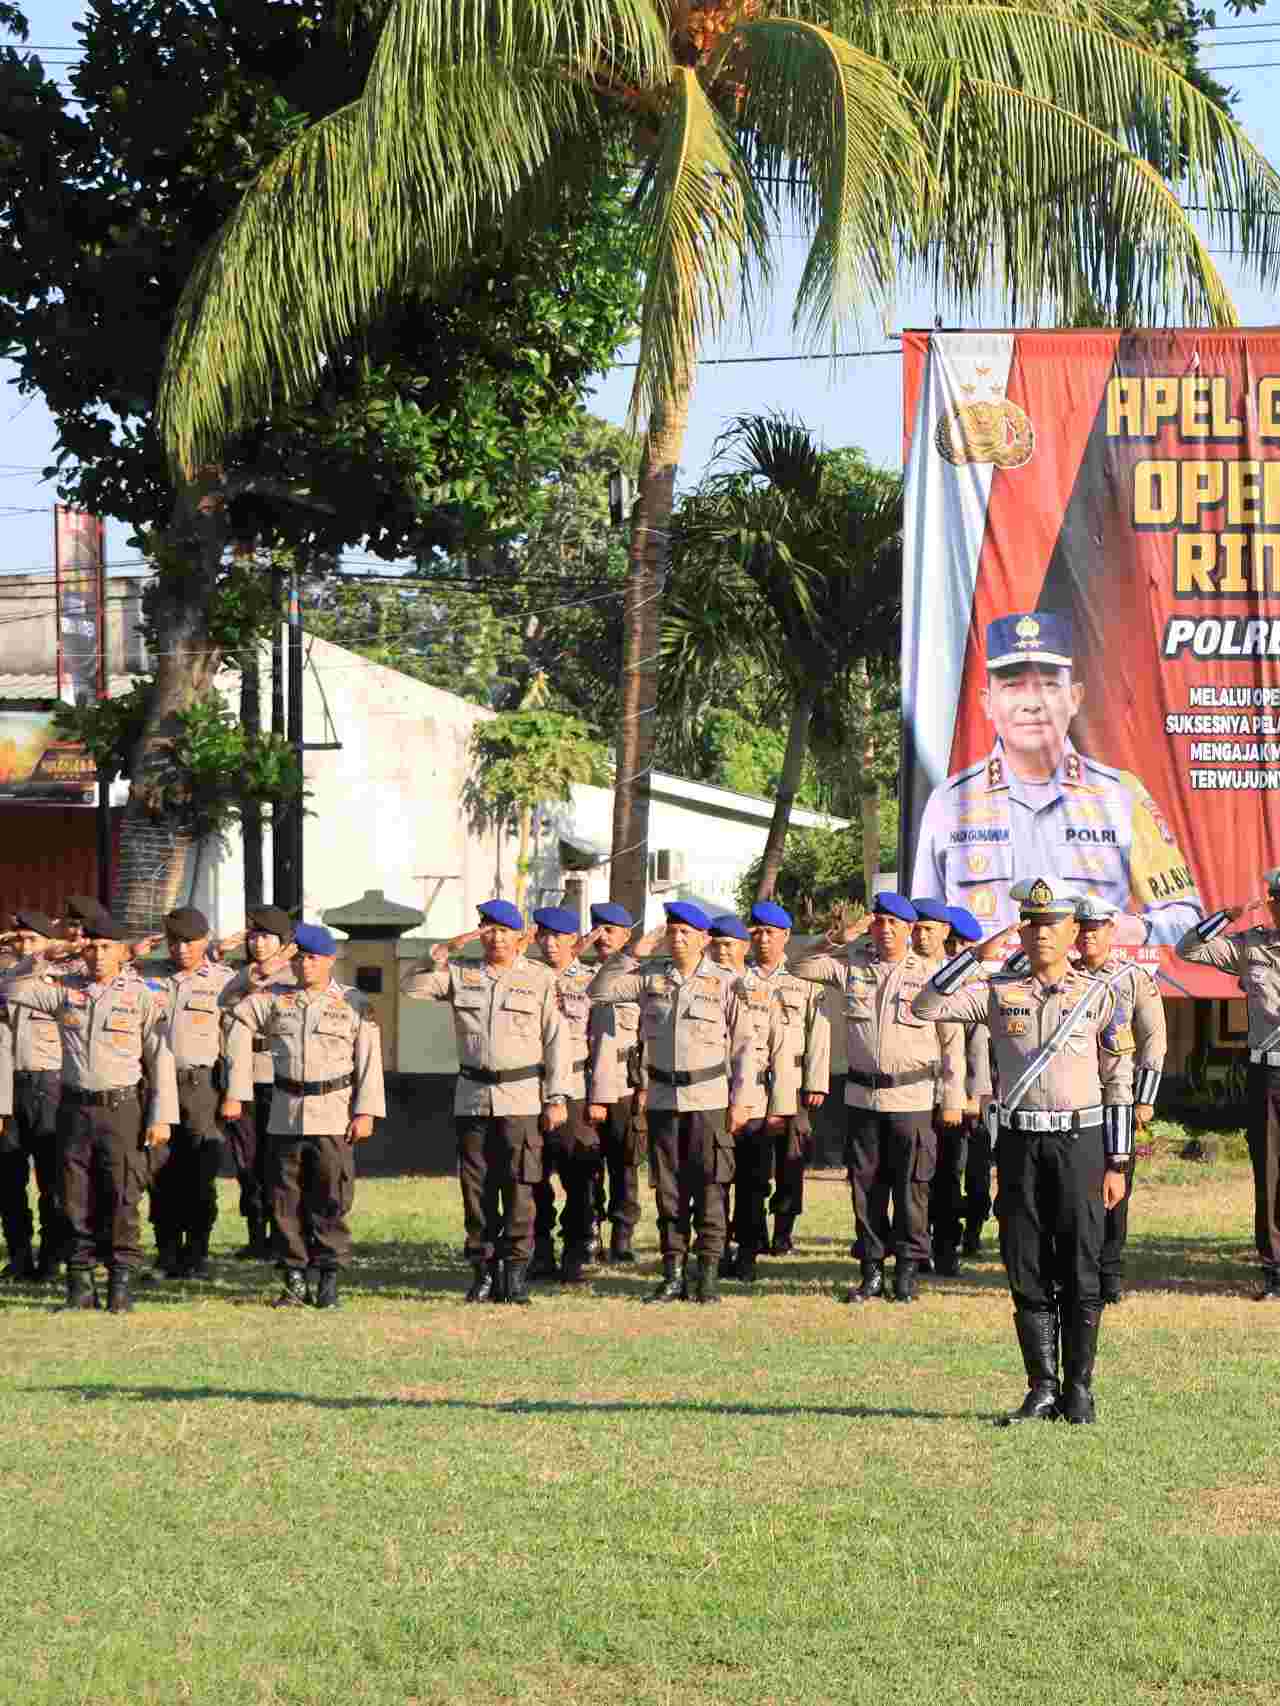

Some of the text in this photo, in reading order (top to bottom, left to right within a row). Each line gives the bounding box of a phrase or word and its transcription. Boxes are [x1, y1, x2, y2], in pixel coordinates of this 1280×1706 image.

[1106, 376, 1243, 437] APEL
[1189, 687, 1251, 706] MELALUI
[1166, 714, 1250, 734] SUKSESNYA
[1190, 742, 1270, 762] MENGAJAK
[1064, 826, 1119, 844] POLRI
